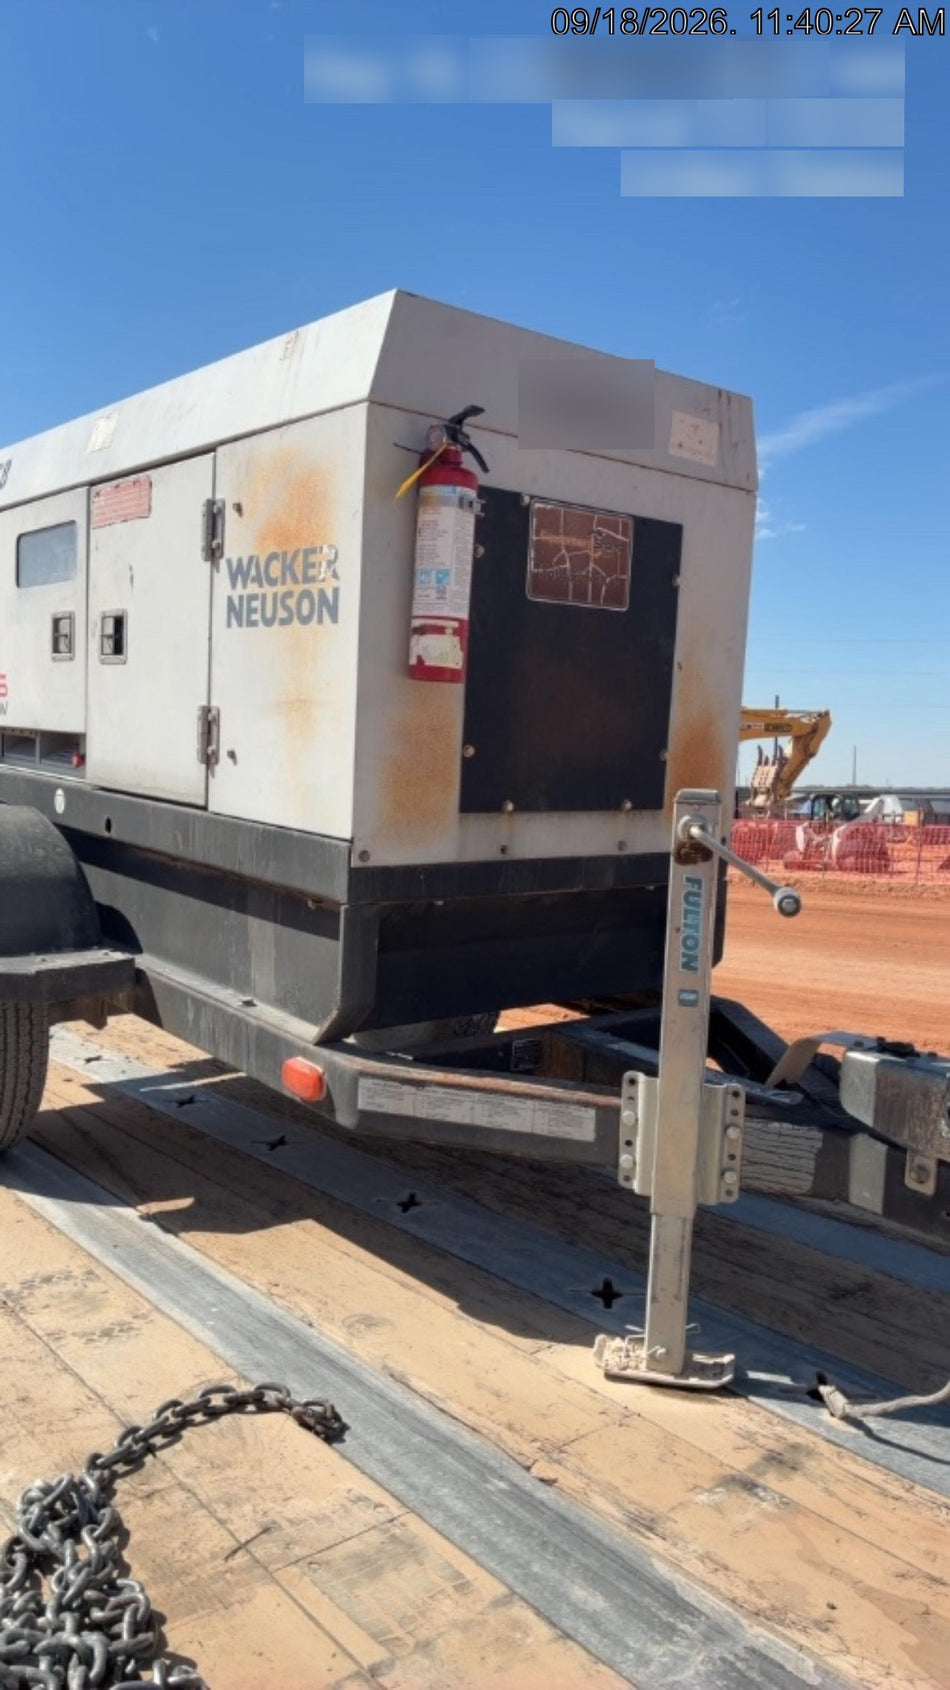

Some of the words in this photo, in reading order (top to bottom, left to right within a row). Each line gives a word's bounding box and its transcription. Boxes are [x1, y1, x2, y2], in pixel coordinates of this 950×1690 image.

[225, 543, 341, 591] WACKER
[226, 586, 340, 629] NEUSON
[680, 875, 704, 972] FULTON
